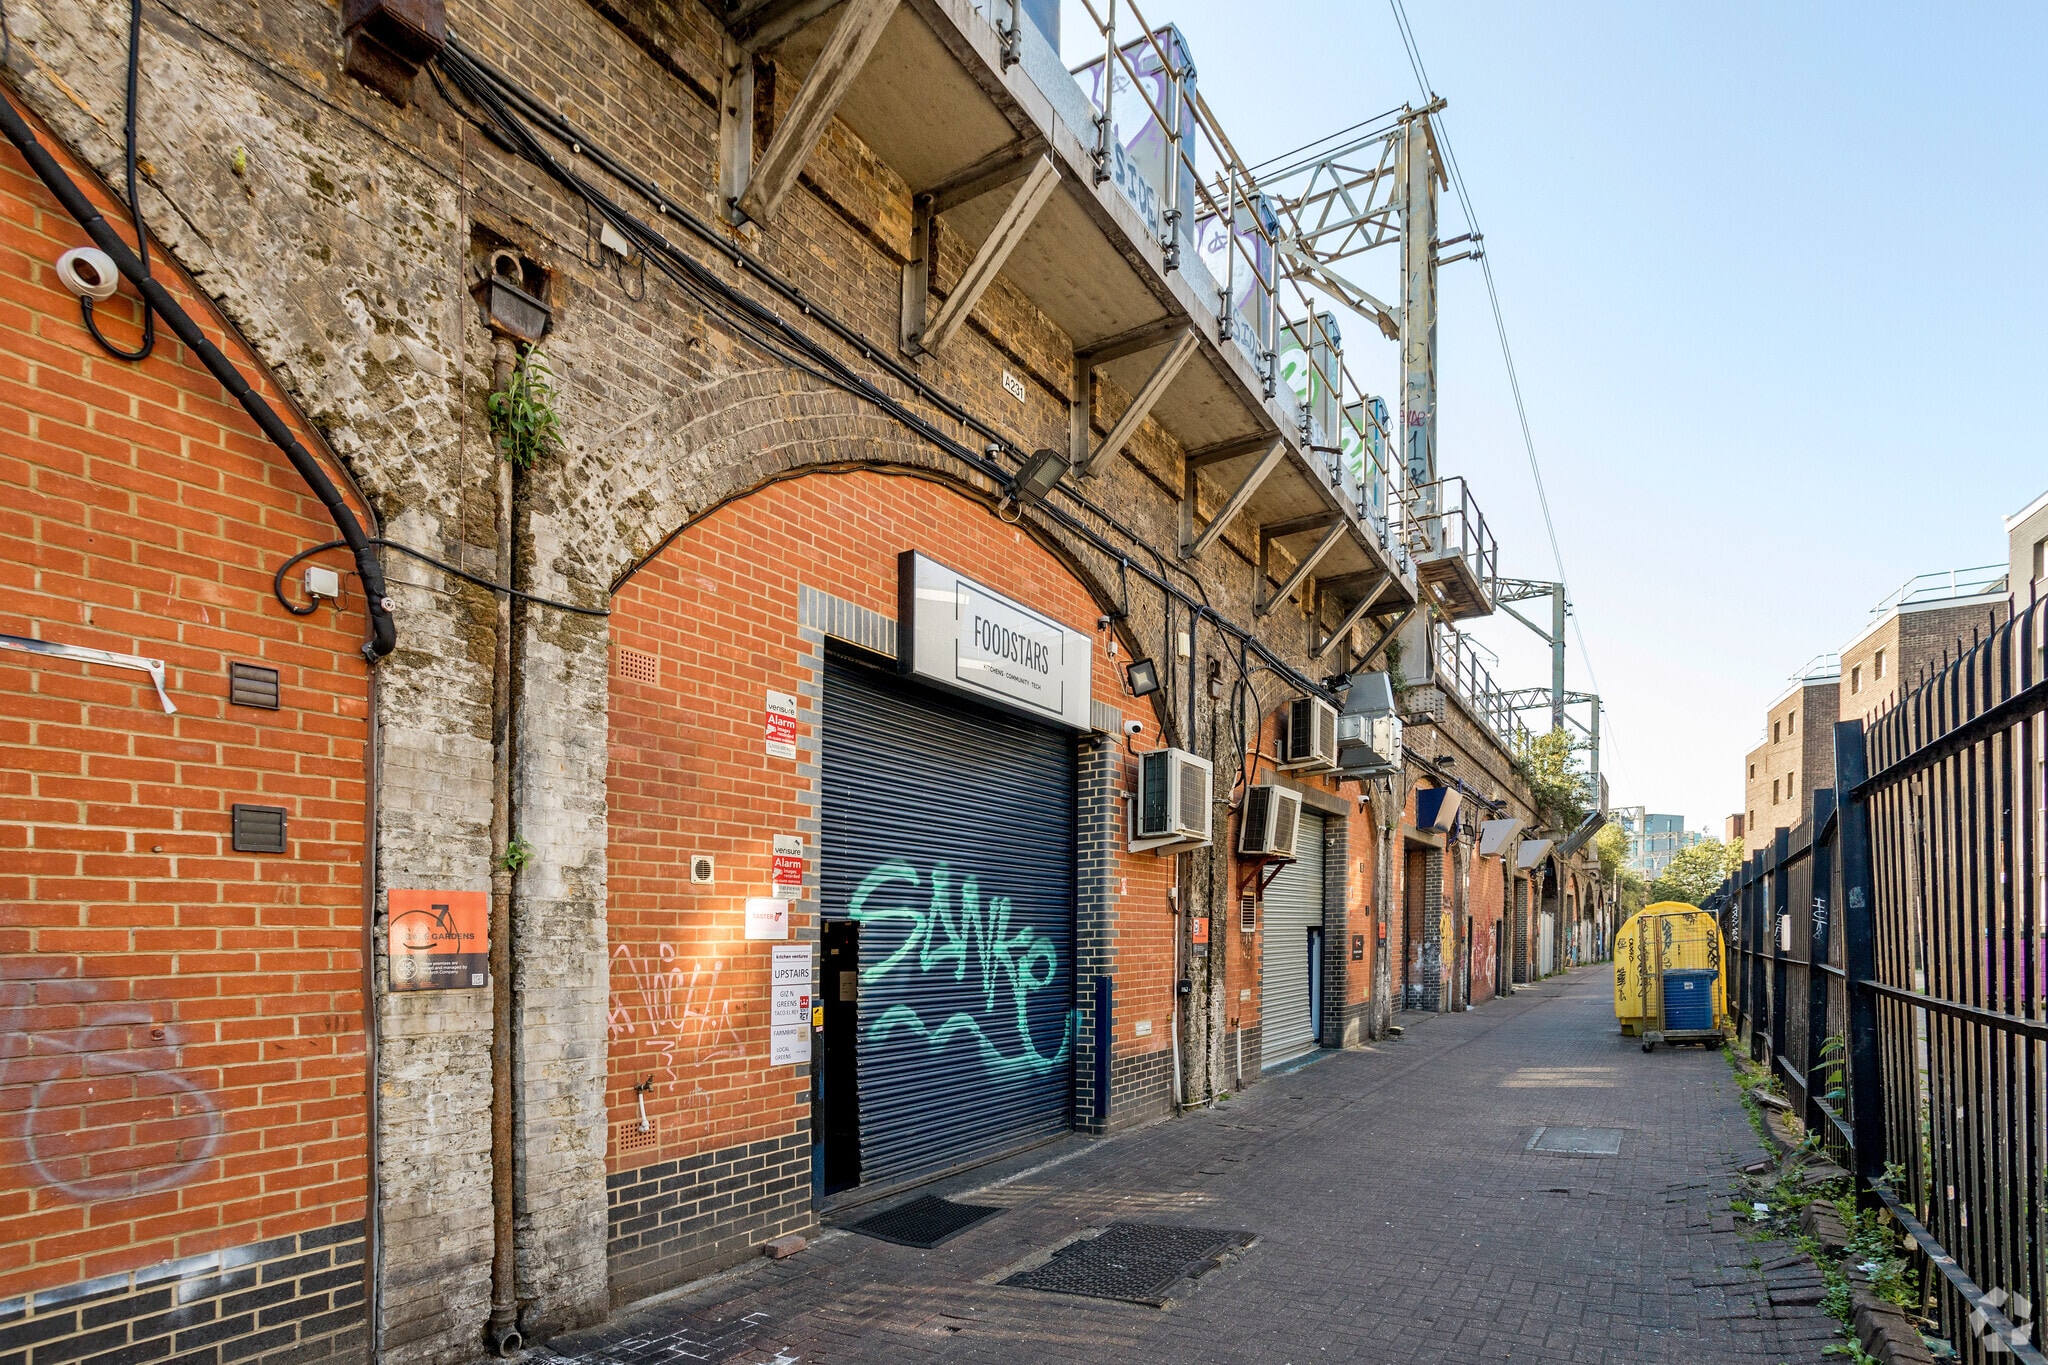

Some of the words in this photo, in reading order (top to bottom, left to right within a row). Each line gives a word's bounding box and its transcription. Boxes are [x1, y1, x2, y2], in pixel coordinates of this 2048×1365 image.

[1115, 143, 1157, 230] SIDE
[1005, 375, 1024, 399] A231
[975, 614, 1049, 675] FOODSTARS
[983, 664, 1004, 677] KITCHENS
[1005, 672, 1030, 686] COMMUNITY
[1031, 681, 1042, 690] TECH
[768, 703, 795, 716] verisure
[767, 714, 796, 729] Alarm
[774, 847, 801, 856] verisure
[774, 857, 801, 869] Alarm
[431, 904, 450, 927] 7
[431, 932, 475, 940] GARDENS
[775, 969, 809, 978] UPSTAIRS
[776, 1000, 797, 1008] GREENS
